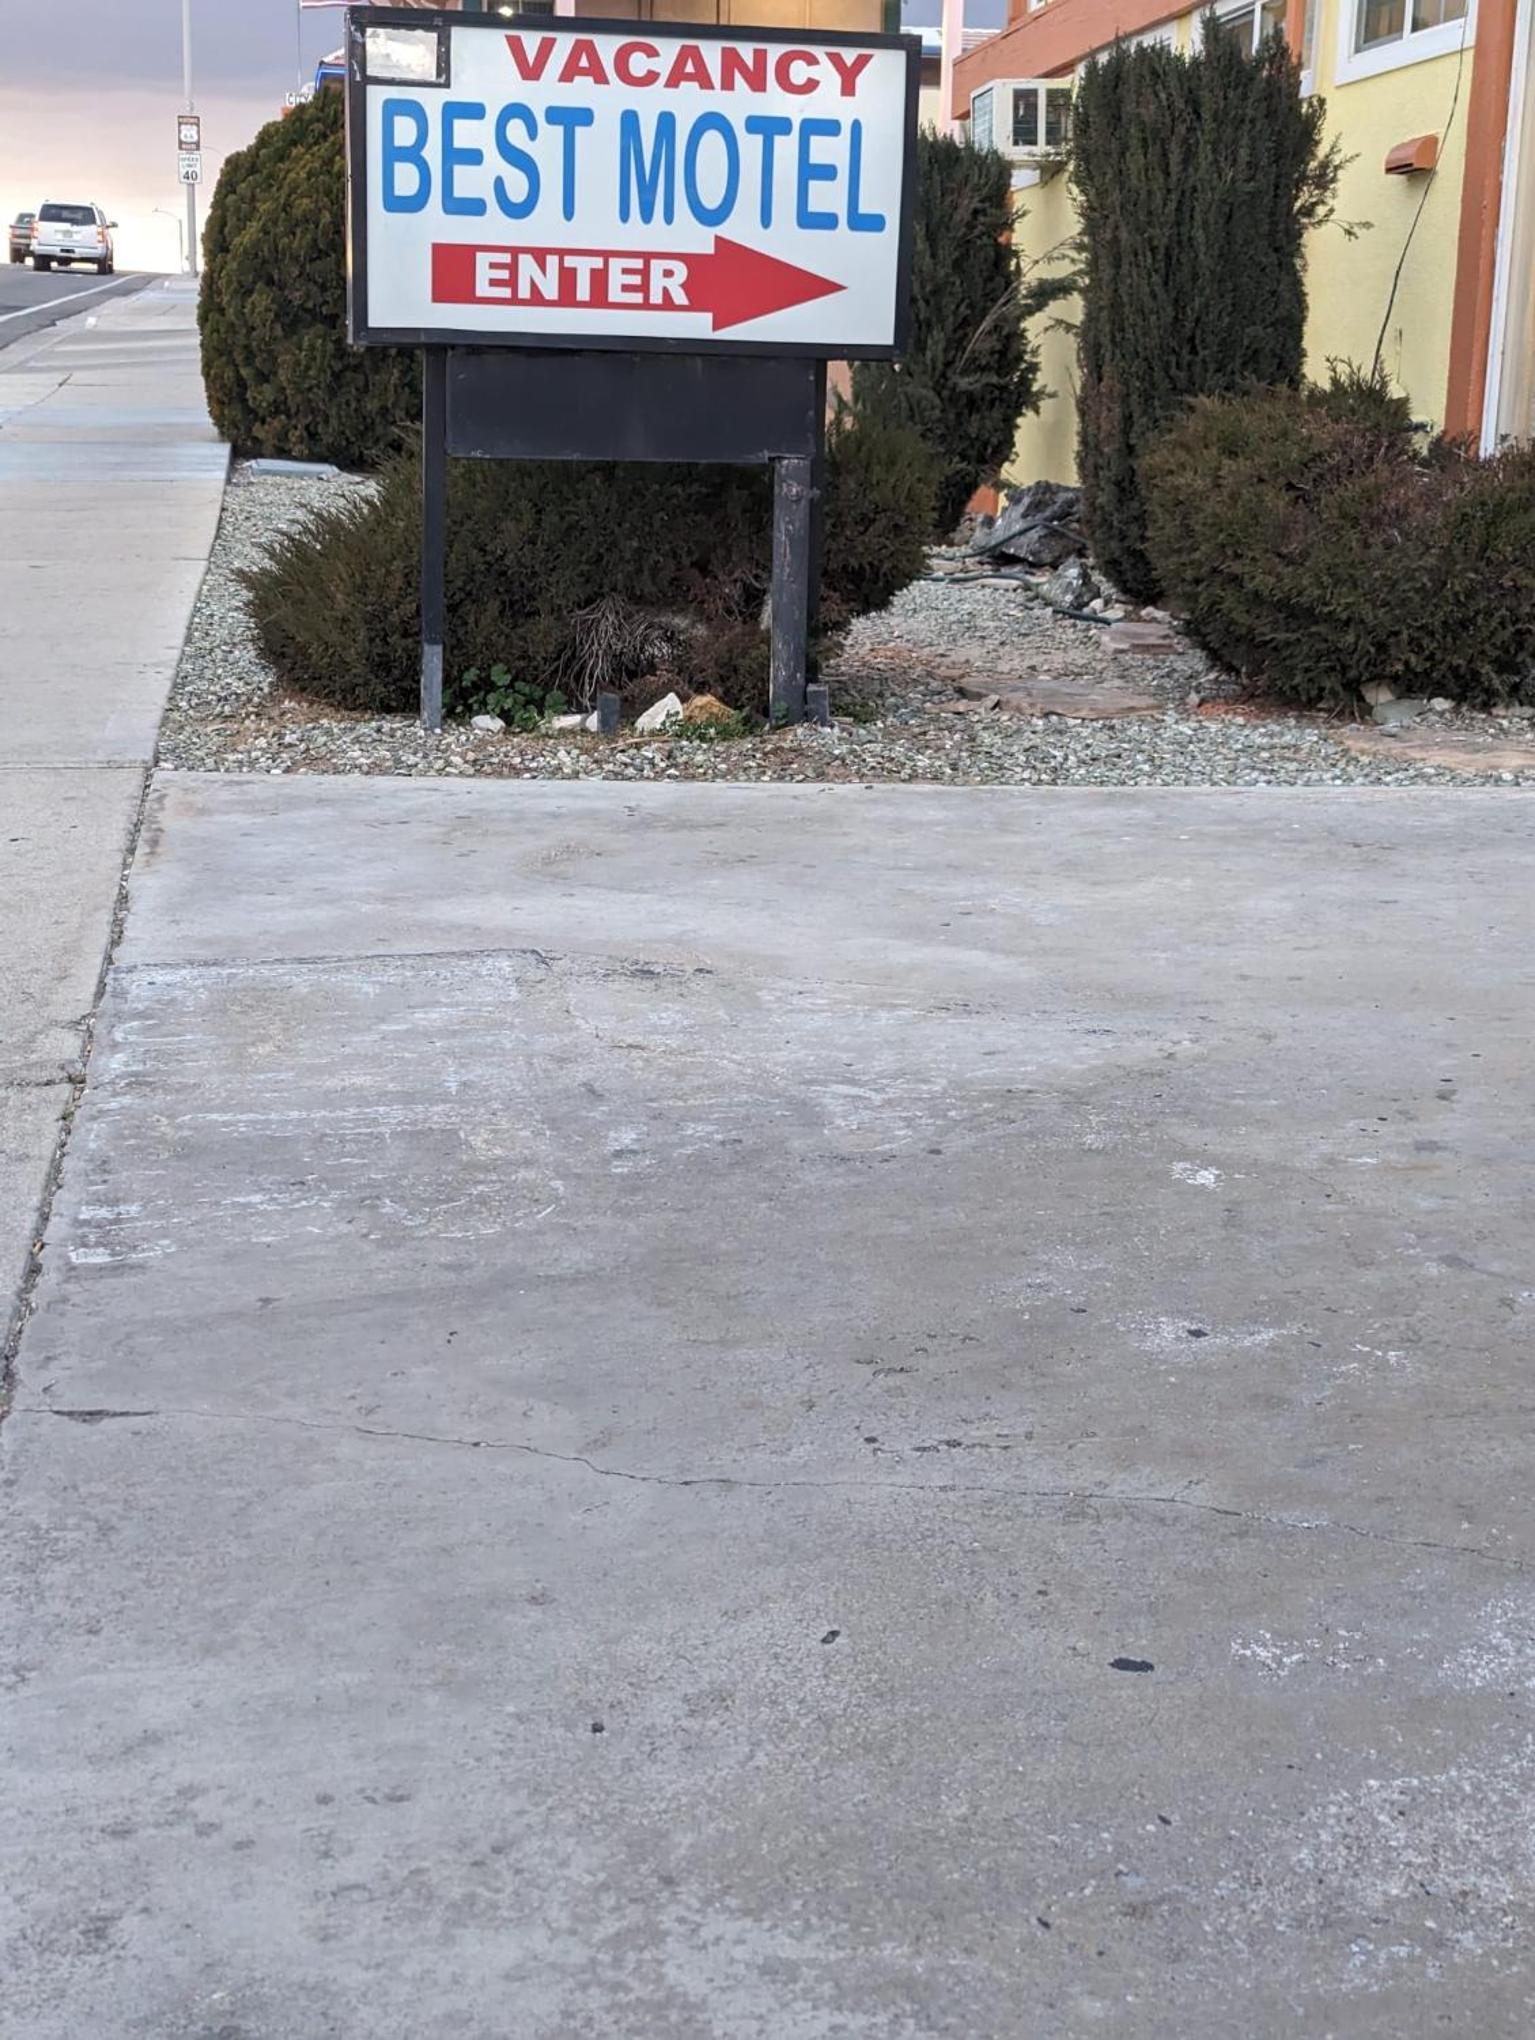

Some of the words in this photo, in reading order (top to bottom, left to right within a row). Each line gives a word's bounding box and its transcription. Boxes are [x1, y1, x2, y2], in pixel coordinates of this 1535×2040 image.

[506, 35, 874, 97] VACANCY
[183, 170, 198, 182] 40
[381, 98, 595, 221] BEST
[618, 108, 887, 233] MOTEL
[474, 251, 690, 306] ENTER
